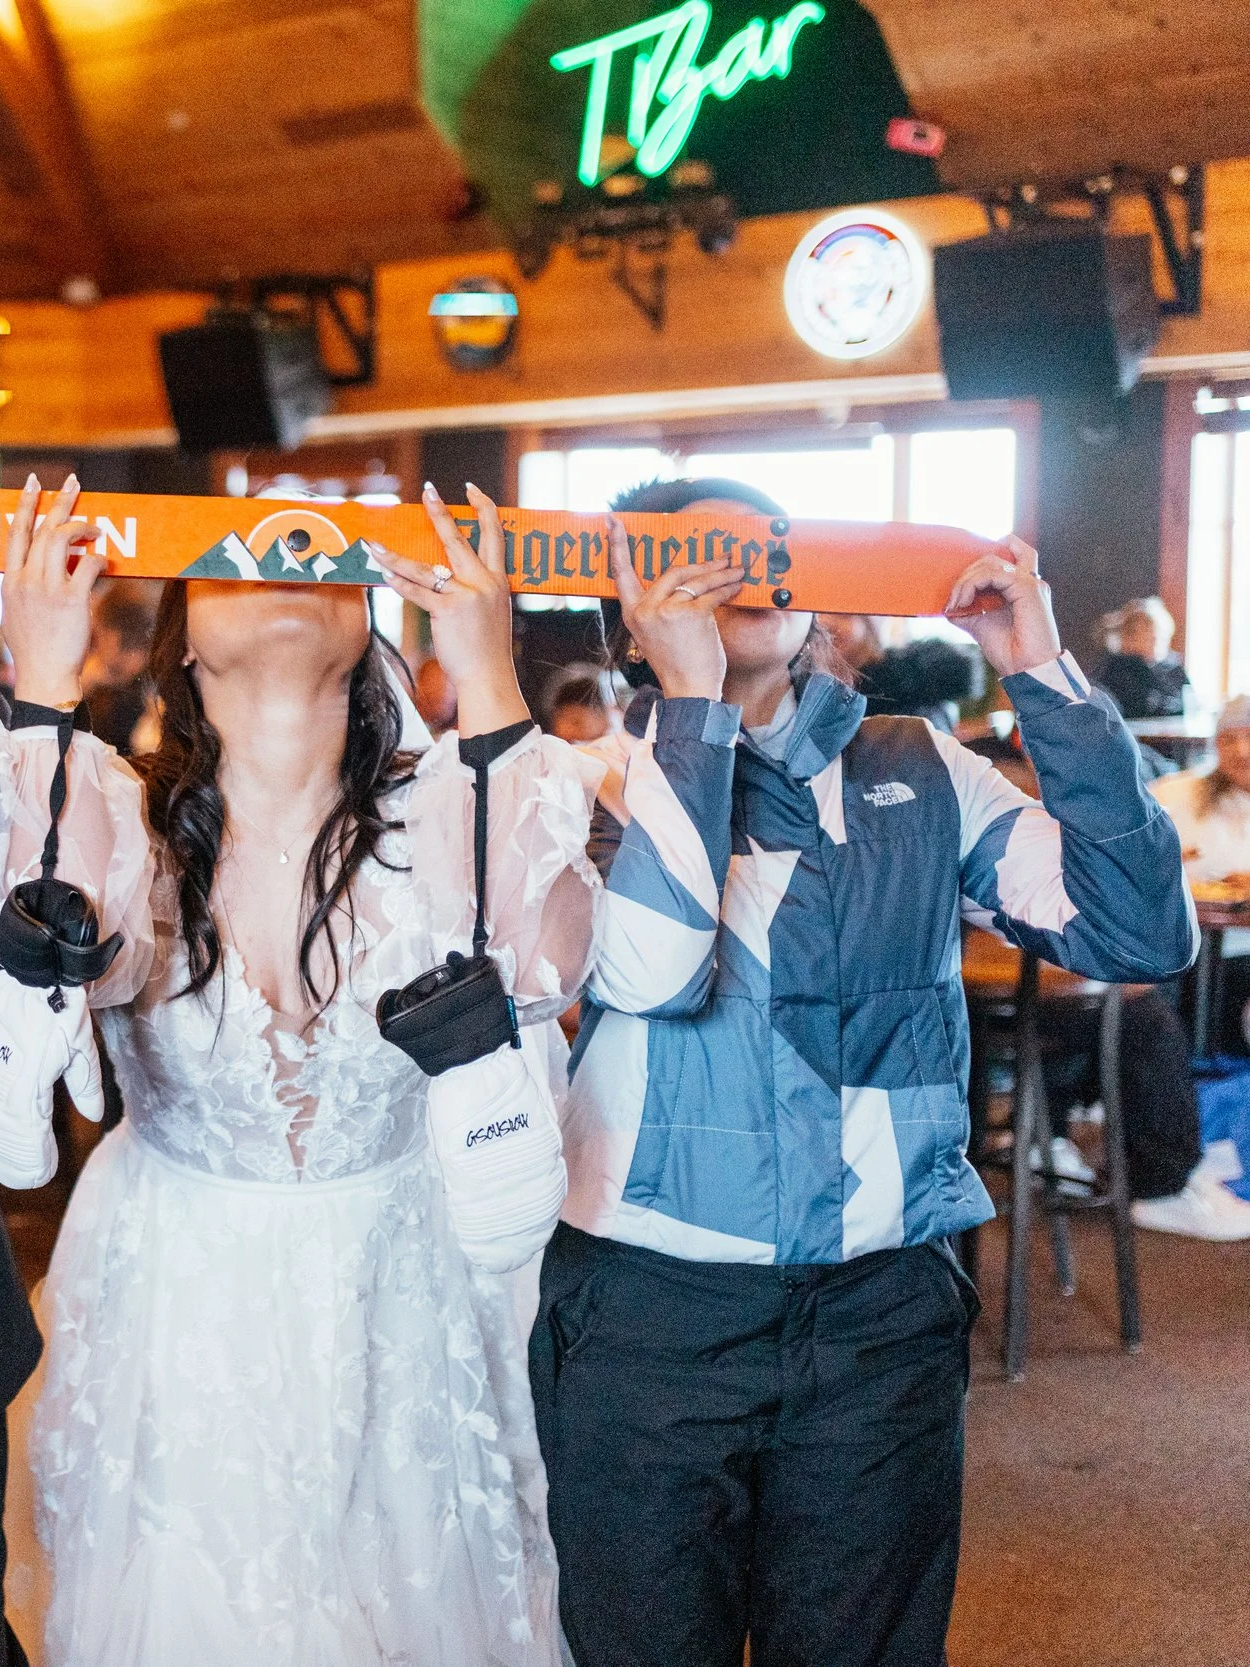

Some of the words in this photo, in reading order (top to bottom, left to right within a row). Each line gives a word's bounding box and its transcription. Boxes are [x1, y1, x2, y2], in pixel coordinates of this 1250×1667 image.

[873, 783, 892, 793] THE
[863, 790, 897, 802] NORTH
[874, 796, 899, 808] FACE
